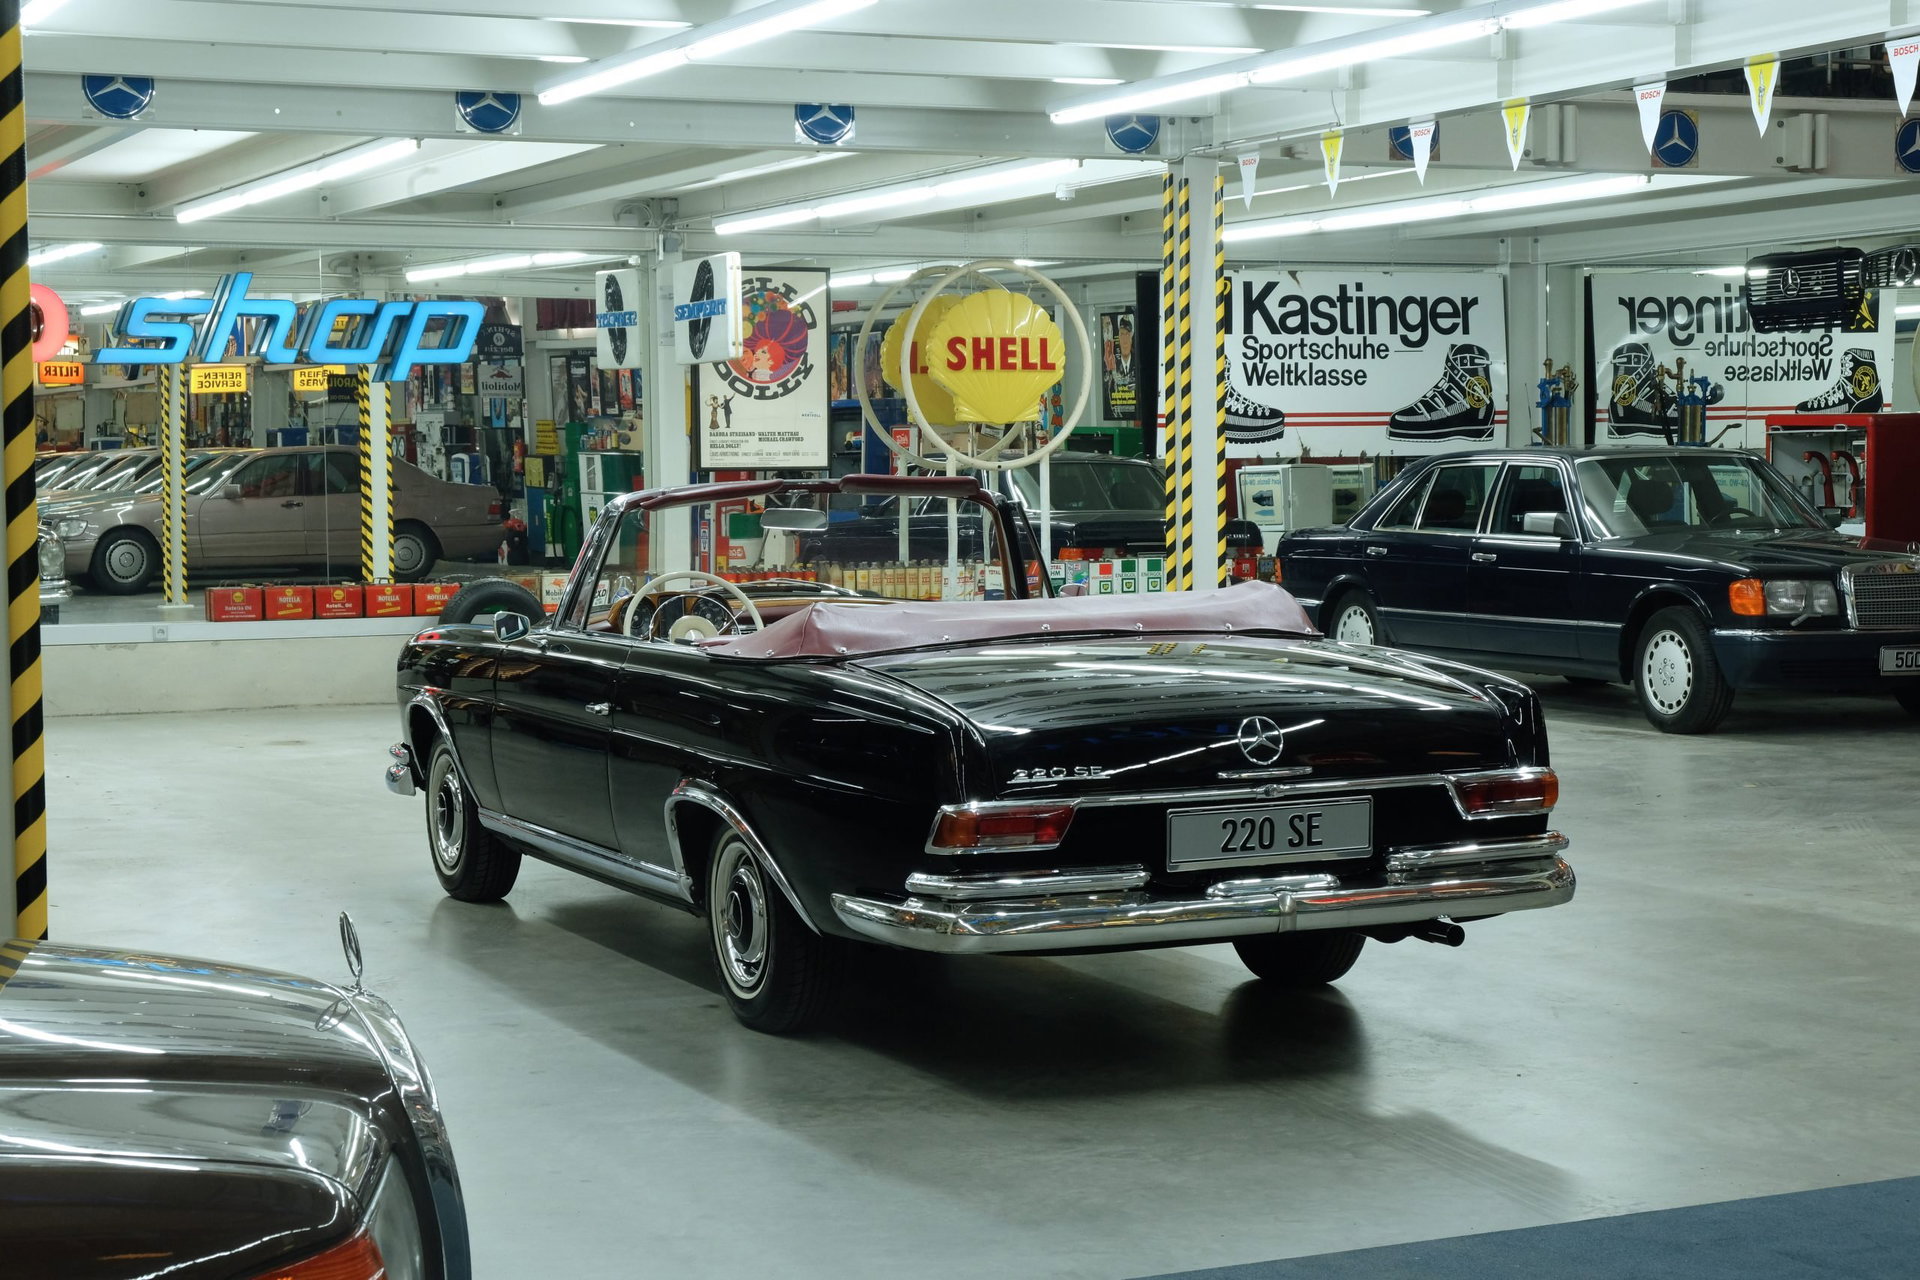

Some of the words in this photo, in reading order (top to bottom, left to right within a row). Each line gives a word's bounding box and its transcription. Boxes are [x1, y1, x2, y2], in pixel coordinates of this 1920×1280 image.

[1893, 44, 1919, 57] BOSCH
[1640, 89, 1661, 100] BOSCH
[1413, 128, 1431, 138] BOSCH
[1242, 158, 1257, 166] BOSCH
[742, 277, 818, 330] ELLO
[1242, 280, 1479, 348] Kastinger
[946, 336, 1056, 372] SHELL
[1242, 335, 1390, 364] Sportschuhe
[712, 352, 815, 400] DOLLY
[1242, 362, 1368, 387] Weltklasse
[1011, 766, 1067, 782] 220
[1220, 815, 1276, 853] 220
[1287, 811, 1323, 848] SE
